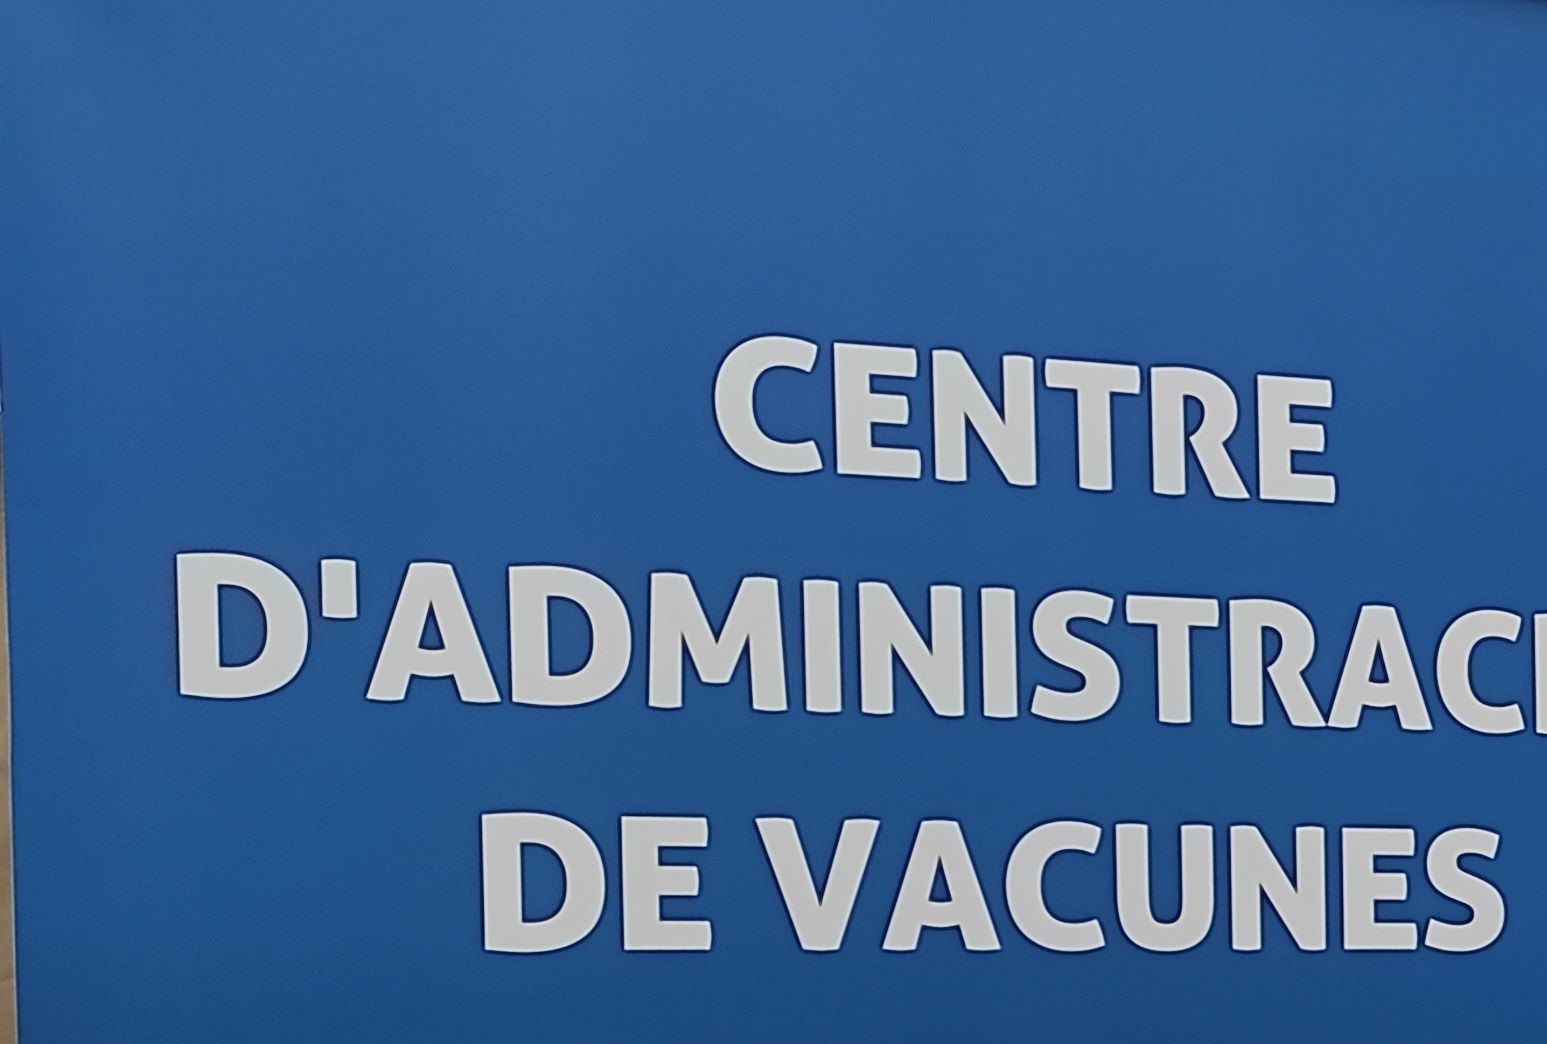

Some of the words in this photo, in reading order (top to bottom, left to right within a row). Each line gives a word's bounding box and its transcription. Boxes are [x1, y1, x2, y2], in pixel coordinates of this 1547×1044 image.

[713, 334, 1338, 504] CENTRE
[480, 811, 713, 954] DE
[755, 816, 1506, 954] VACUNES
